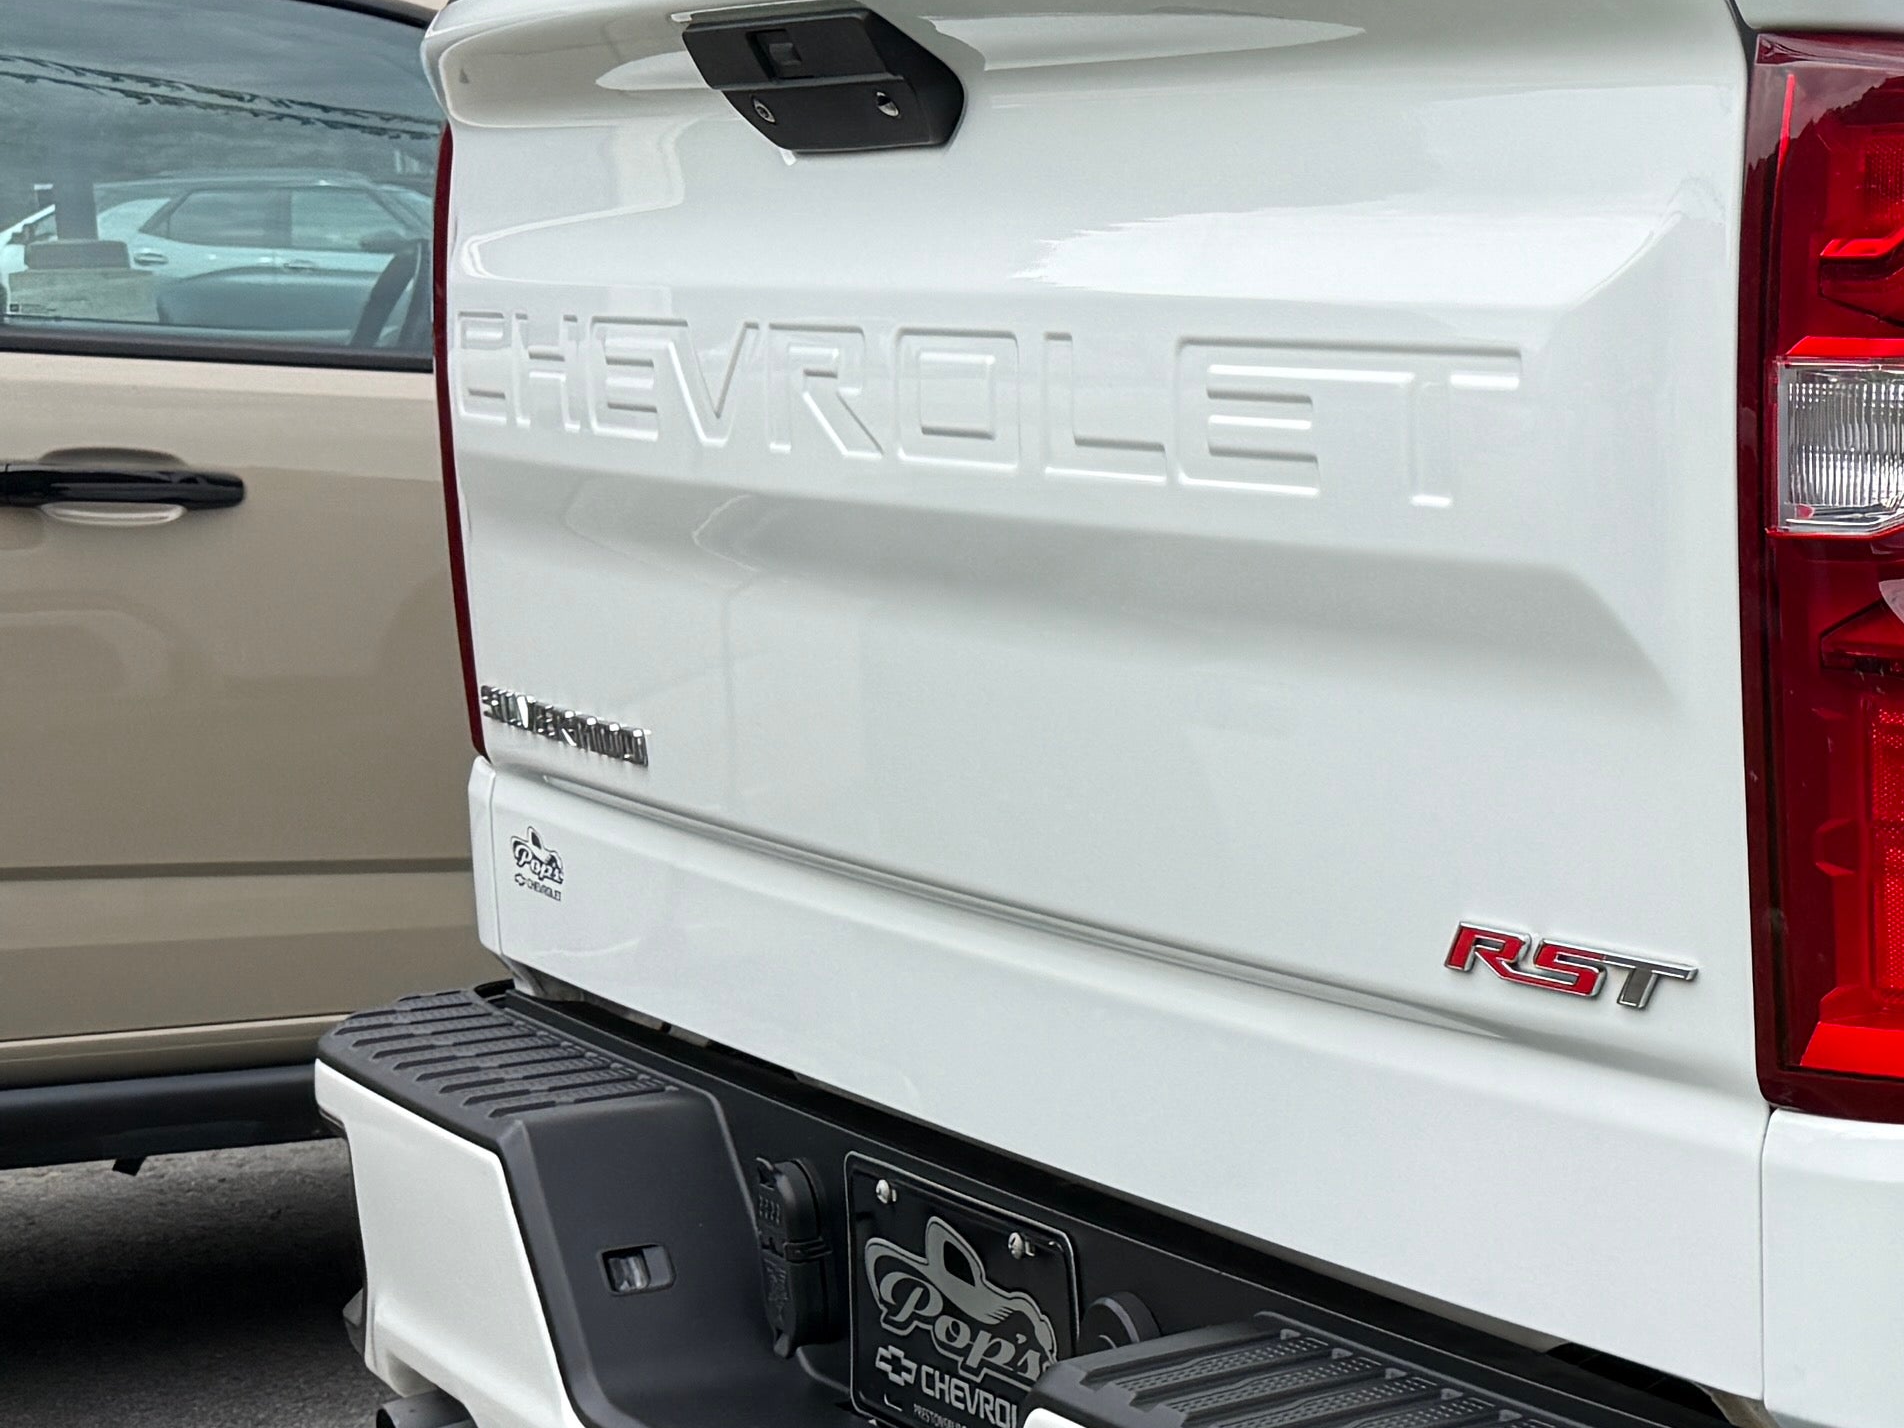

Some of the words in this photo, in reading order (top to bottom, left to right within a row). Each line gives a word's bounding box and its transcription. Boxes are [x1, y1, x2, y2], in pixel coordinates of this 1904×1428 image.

[457, 310, 1523, 509] CHEVROLET
[1445, 921, 1699, 1009] RST
[880, 1271, 1044, 1382] Pop's
